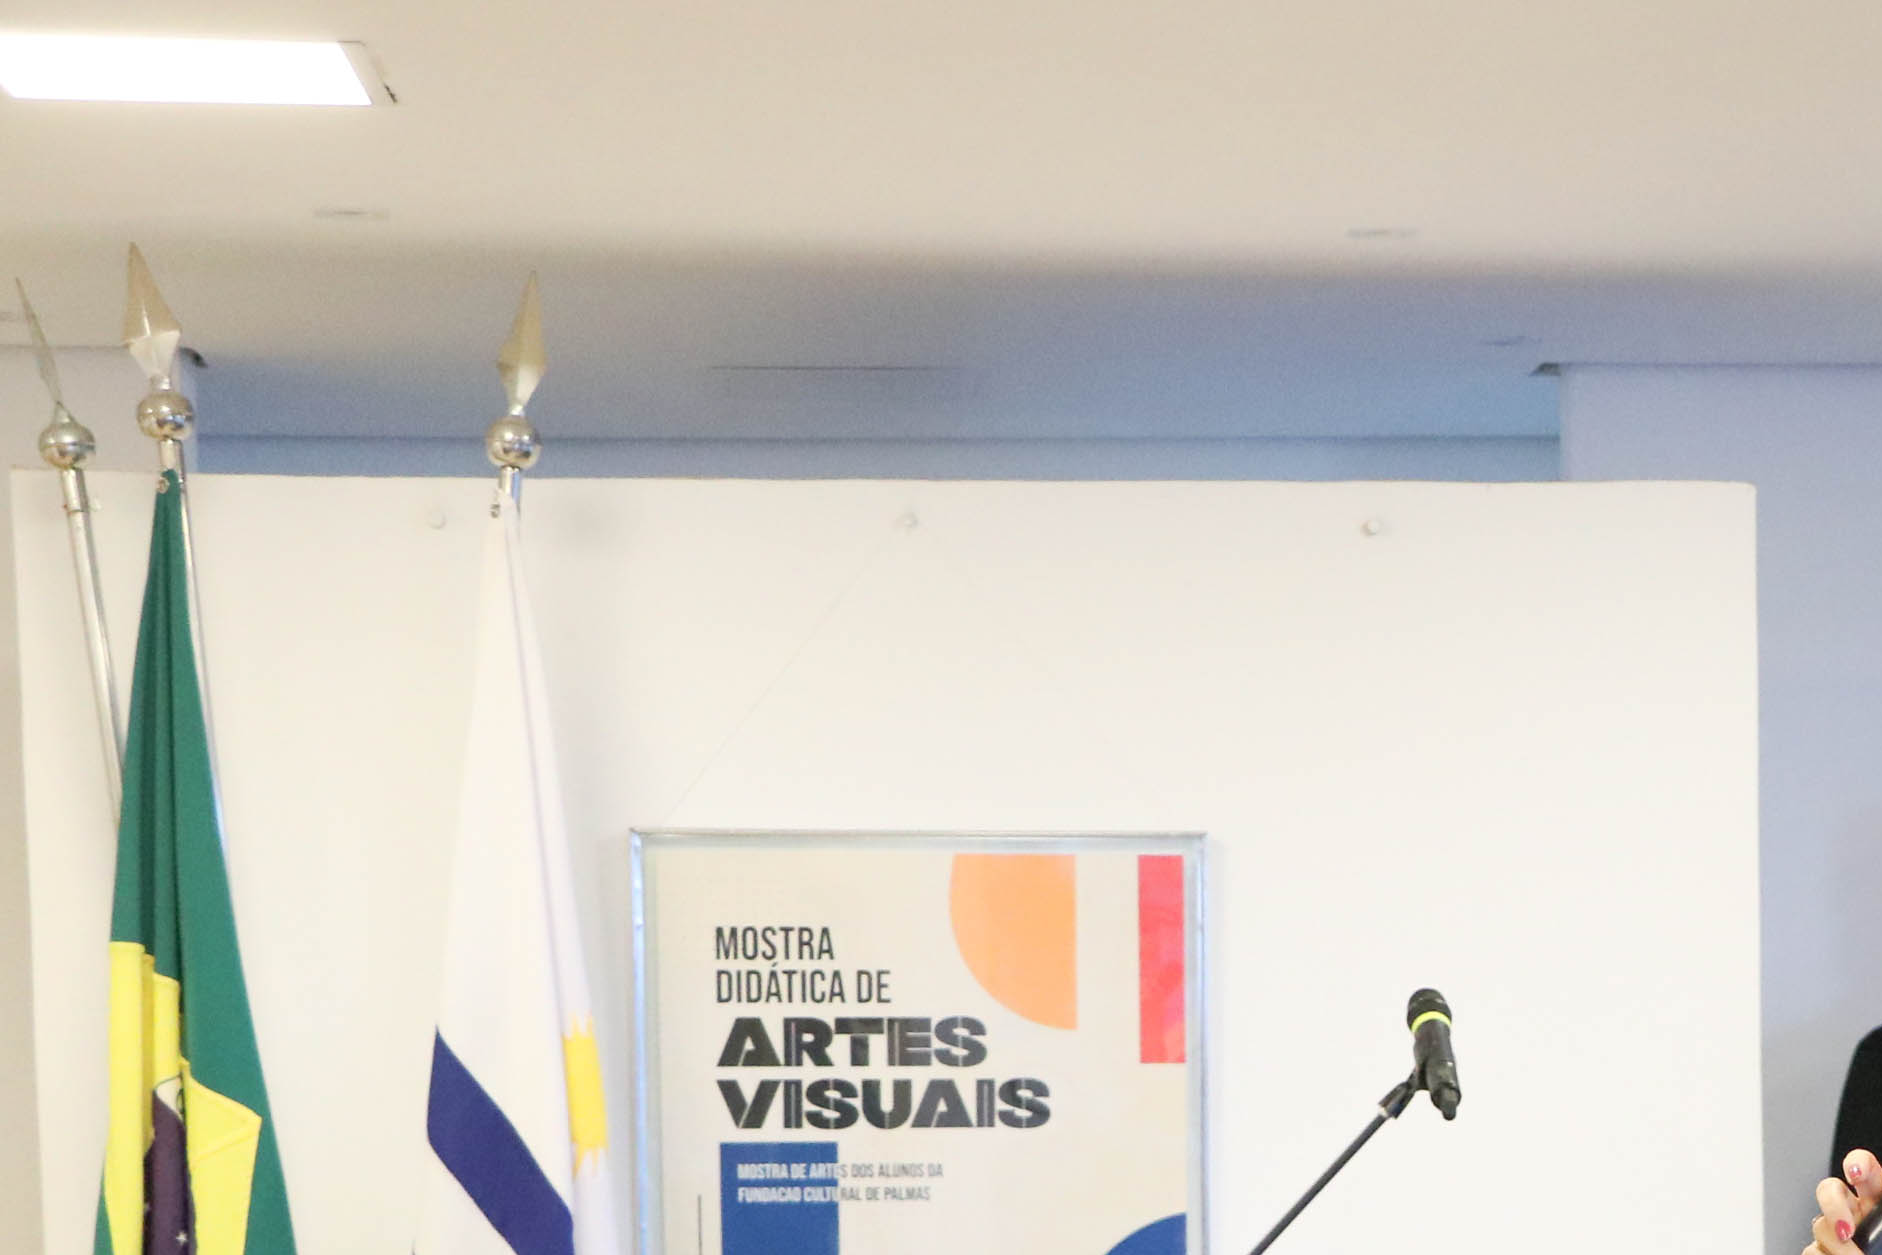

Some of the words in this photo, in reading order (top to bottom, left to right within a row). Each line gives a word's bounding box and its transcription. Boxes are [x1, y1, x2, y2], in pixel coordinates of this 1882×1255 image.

[715, 926, 834, 961] MOSTRA
[716, 964, 846, 1004] DIDÁTICA
[857, 970, 891, 1004] DE
[717, 1016, 988, 1068] ARTES
[716, 1077, 1051, 1130] VISUAIS
[737, 1163, 789, 1179] MOSTRA
[791, 1163, 807, 1179] DE
[810, 1163, 849, 1179] ARTES
[851, 1163, 874, 1178] DOS
[878, 1163, 925, 1178] ALUNOS
[928, 1163, 944, 1178] DA
[804, 1187, 861, 1203] CULTURAL
[866, 1187, 880, 1202] DE
[884, 1186, 931, 1202] PALMAS
